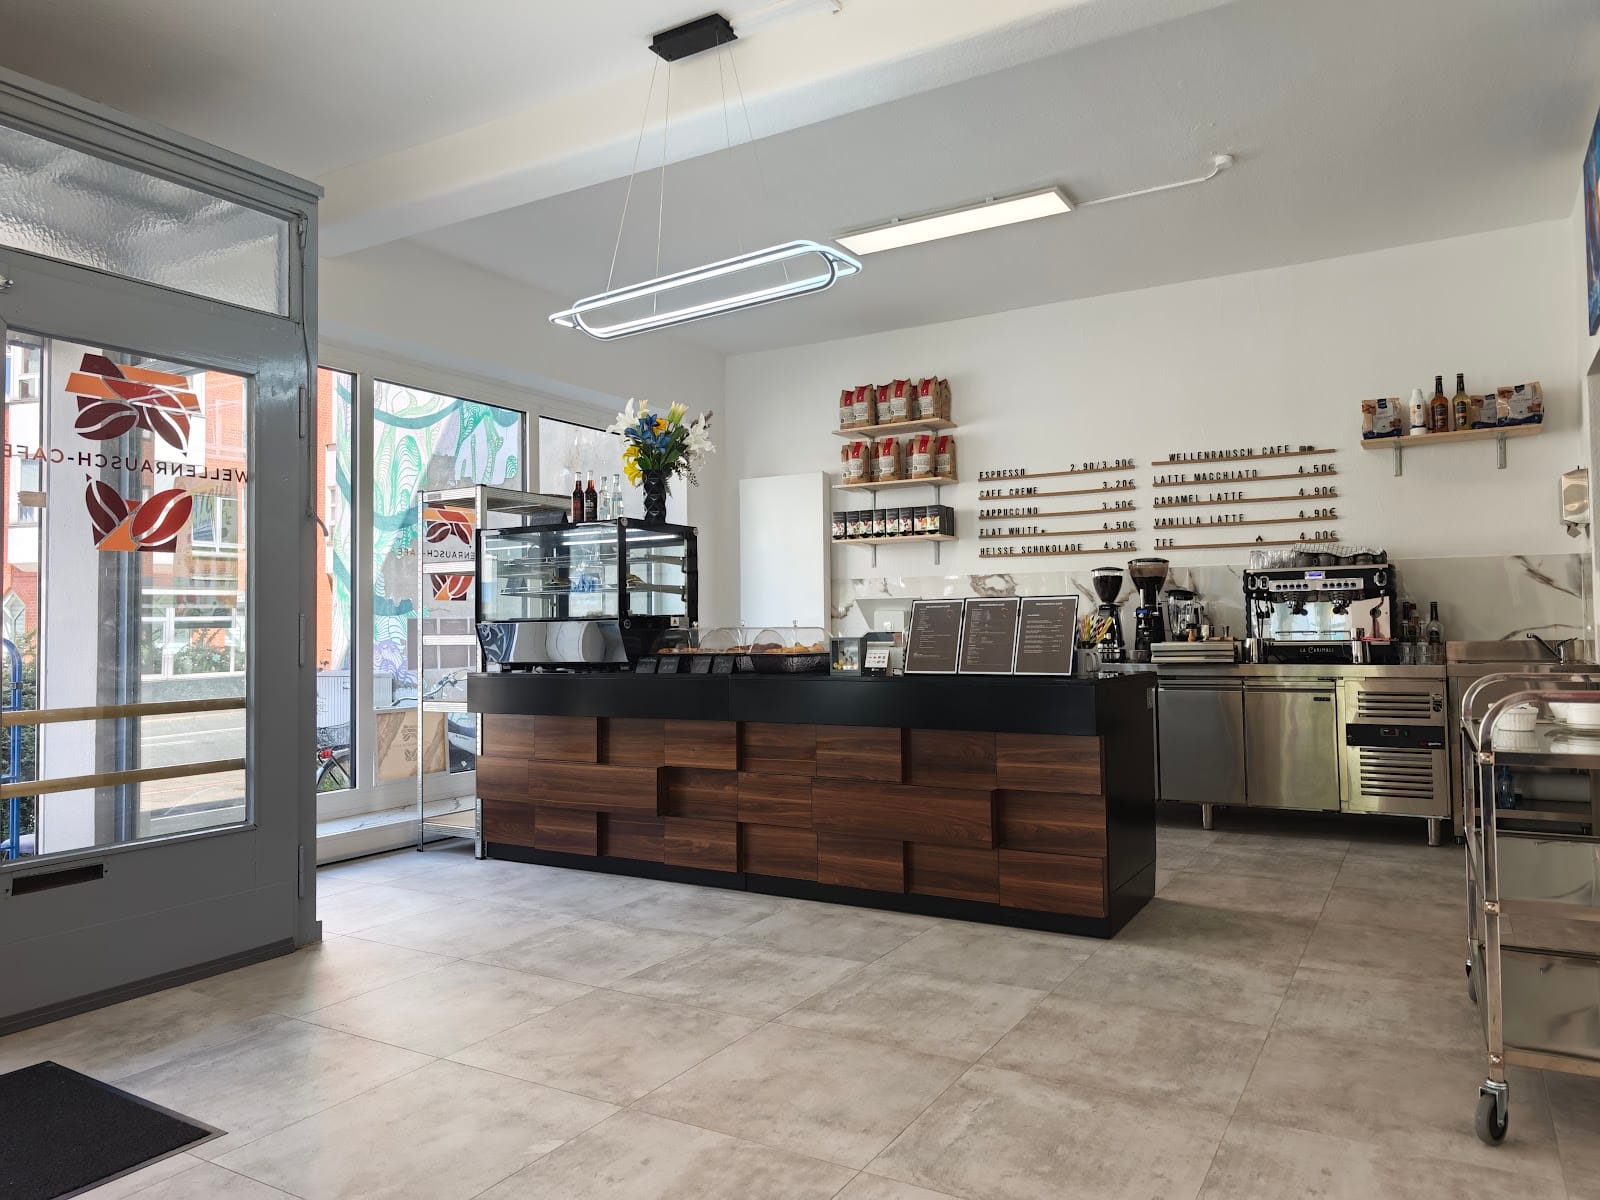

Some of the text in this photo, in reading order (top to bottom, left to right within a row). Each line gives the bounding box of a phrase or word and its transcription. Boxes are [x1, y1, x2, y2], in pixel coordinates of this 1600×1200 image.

[1168, 445, 1290, 462] WELLENRAUSCH CAFE
[979, 468, 1026, 480] ESPRESSO
[1153, 463, 1335, 485] LATTE MACCHIATO 4.50€
[979, 479, 1136, 498] CAFE CREME 3.20€
[1154, 486, 1337, 505] CARAMEL LATTE 4.90€
[979, 500, 1135, 518] CAPPUCCINO 3.50€
[1154, 507, 1338, 526] VANILLA LATTE 4.90€
[979, 527, 1002, 537] FLAT
[1102, 520, 1136, 531] 4.50€
[979, 540, 1136, 556] HEISSE SCHOKOLADE 4.50€
[1155, 530, 1337, 548] TEE 4.00€
